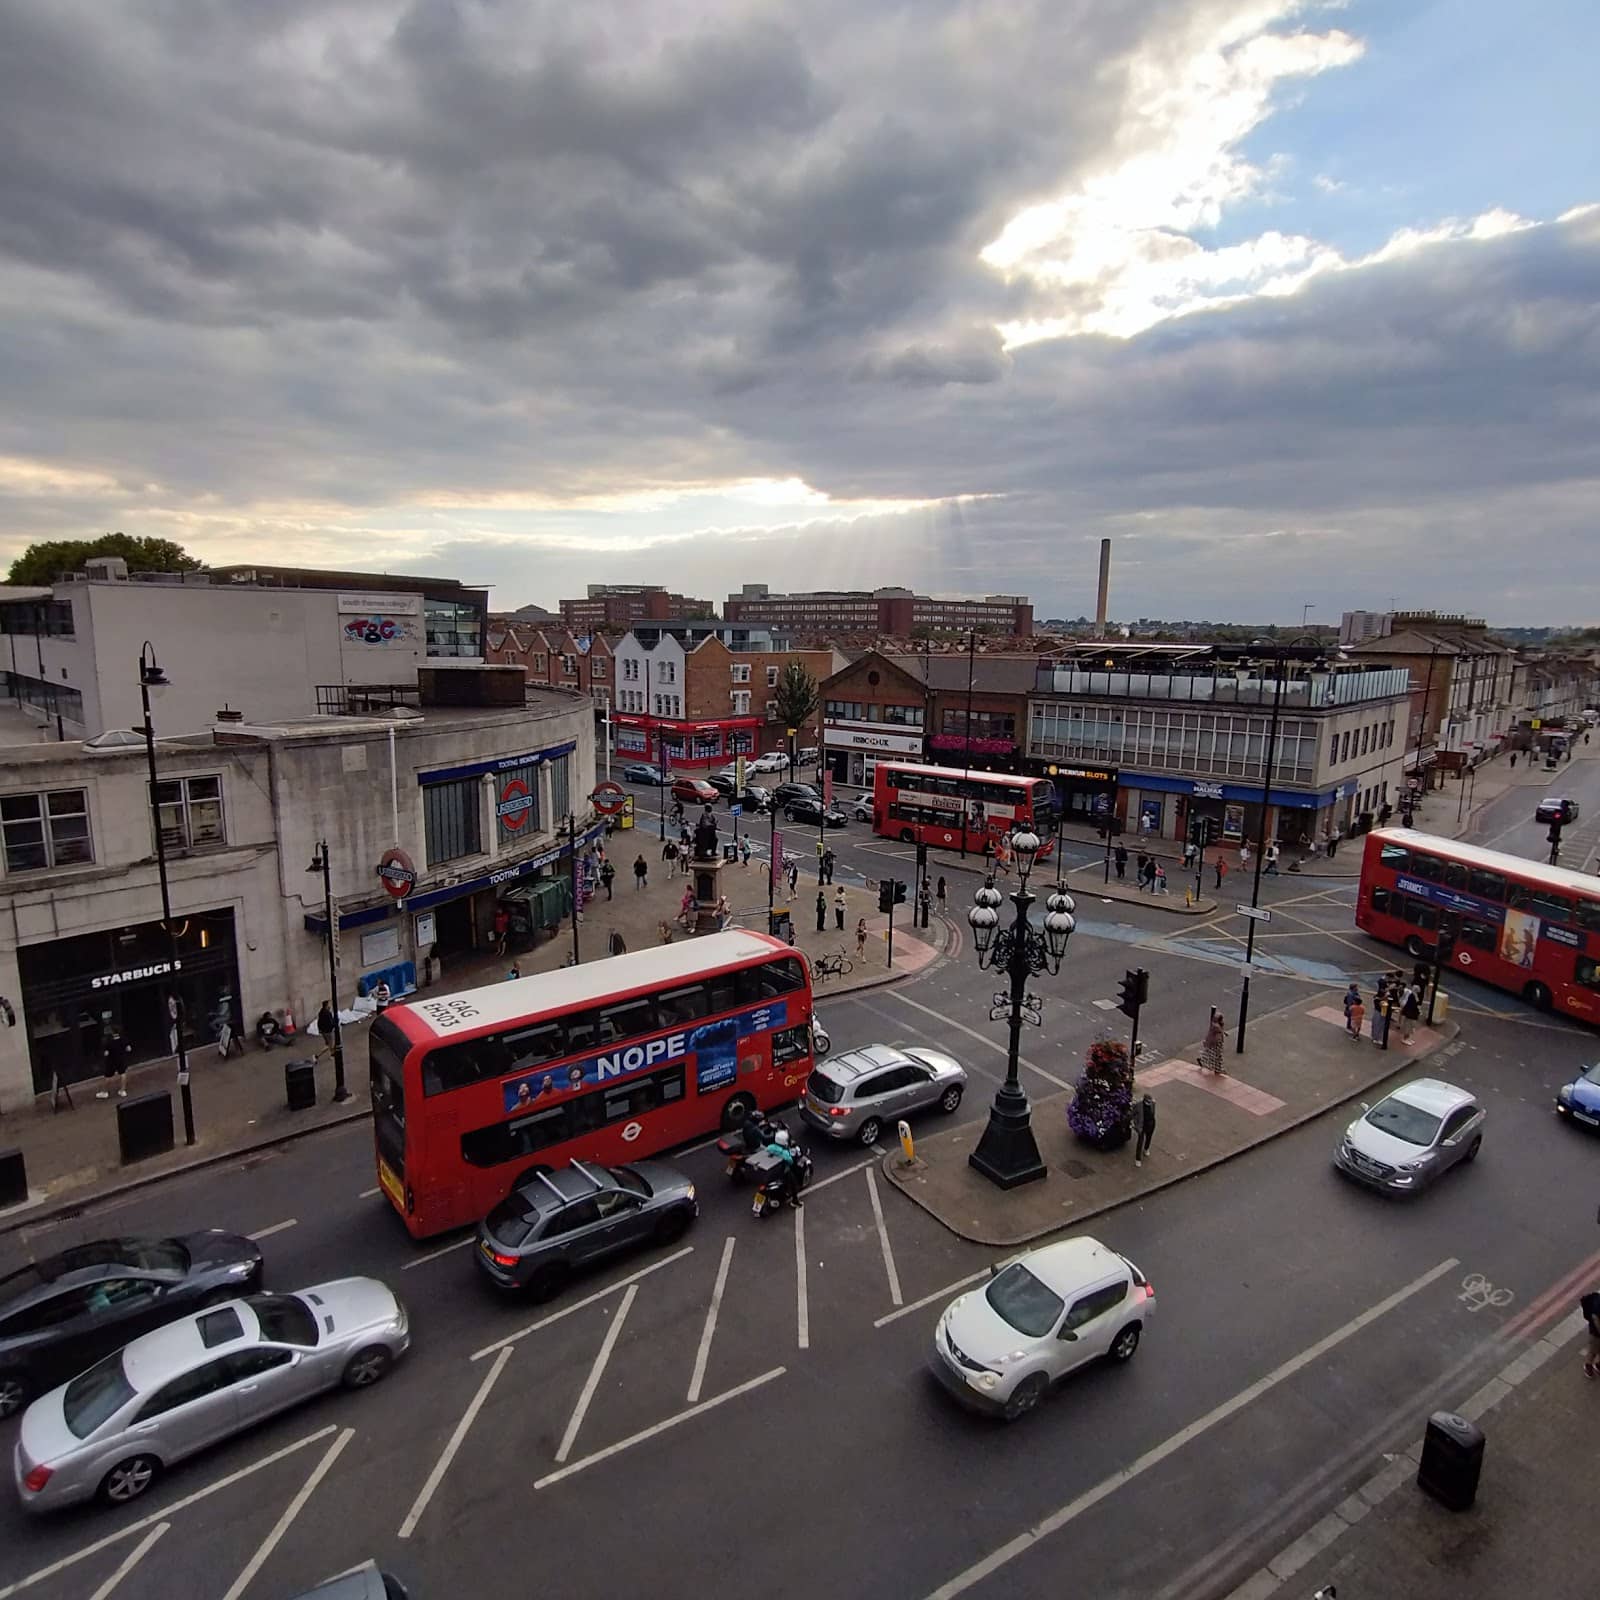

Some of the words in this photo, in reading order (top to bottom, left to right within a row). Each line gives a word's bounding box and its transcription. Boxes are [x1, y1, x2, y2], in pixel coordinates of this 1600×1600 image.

[879, 738, 890, 747] UK
[1086, 771, 1109, 781] SLOTS
[1192, 785, 1224, 796] HALIFAX
[489, 867, 520, 885] TOOTING
[533, 850, 561, 869] BROADWAY
[91, 960, 182, 989] STARBUCKS
[422, 1003, 461, 1027] EH303
[448, 1000, 480, 1018] GAG
[597, 1033, 686, 1081] NOPE
